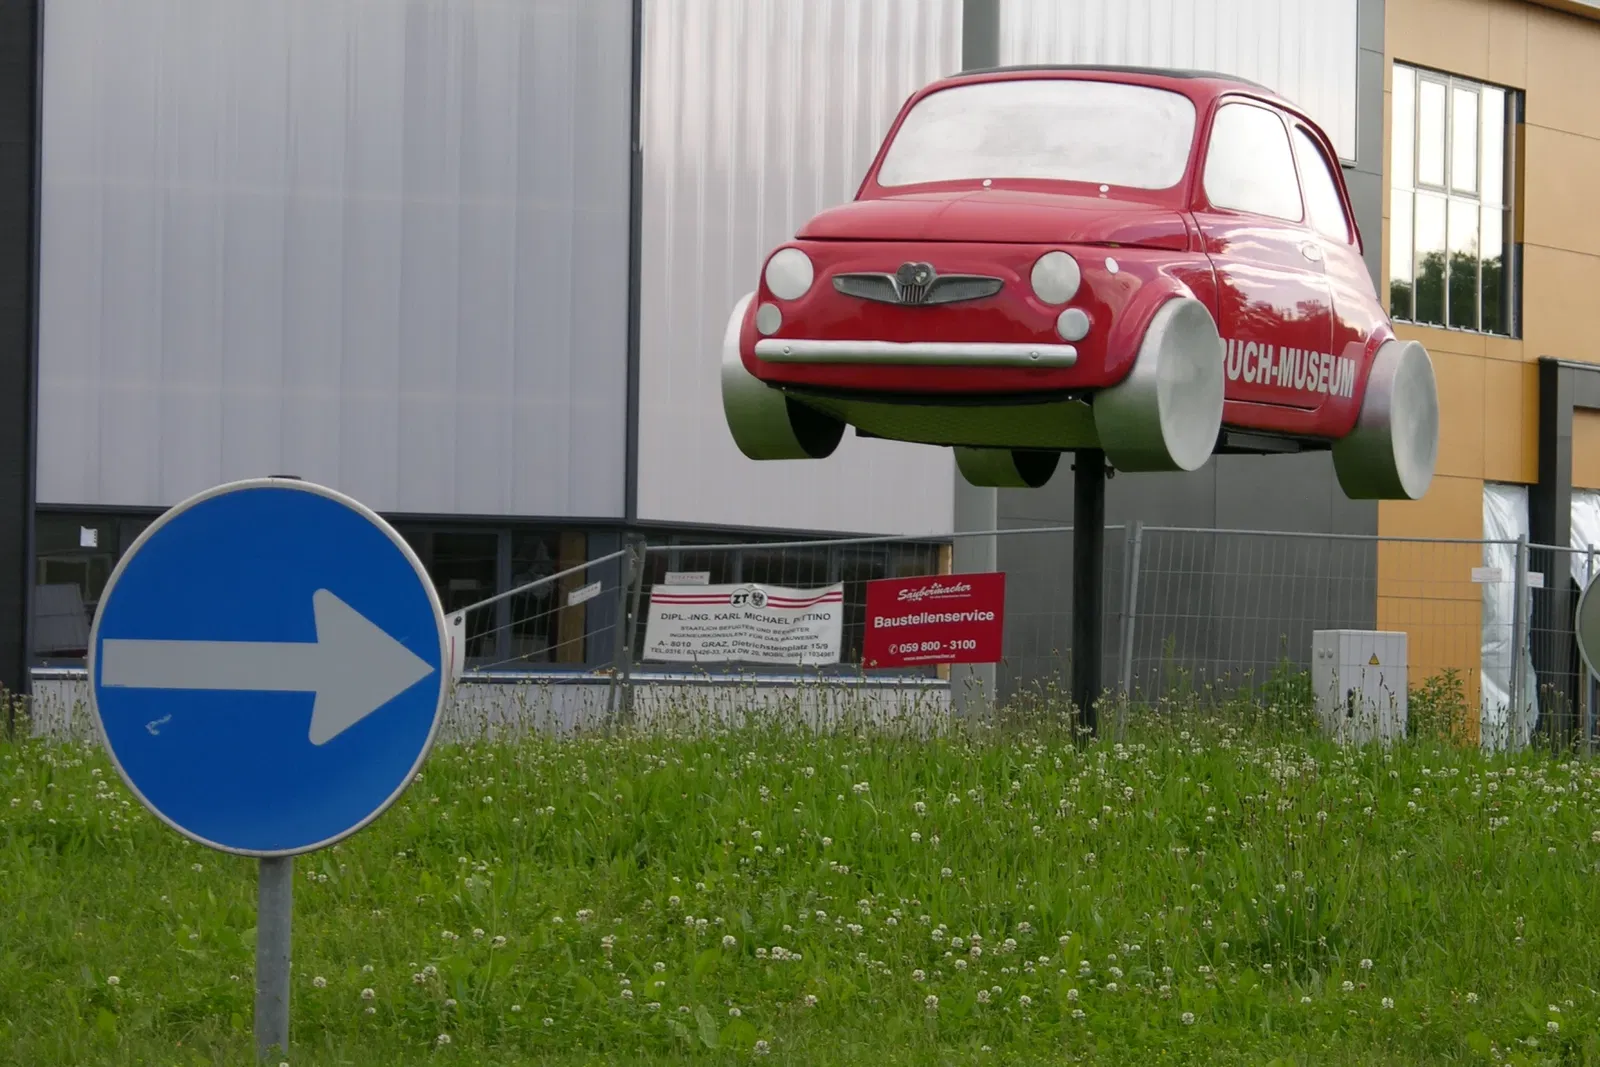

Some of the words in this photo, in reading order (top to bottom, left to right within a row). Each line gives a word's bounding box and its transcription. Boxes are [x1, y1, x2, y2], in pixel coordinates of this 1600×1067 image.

[733, 594, 749, 604] ZT
[660, 613, 711, 621] DIPL.-ING.
[714, 612, 741, 620] KARL
[744, 612, 790, 625] MICHAEL
[874, 609, 995, 628] Baustellenservice
[732, 640, 808, 652] Dietrichsteinplatz
[899, 643, 918, 653] 059
[921, 641, 940, 651] 800
[949, 639, 976, 649] 3100
